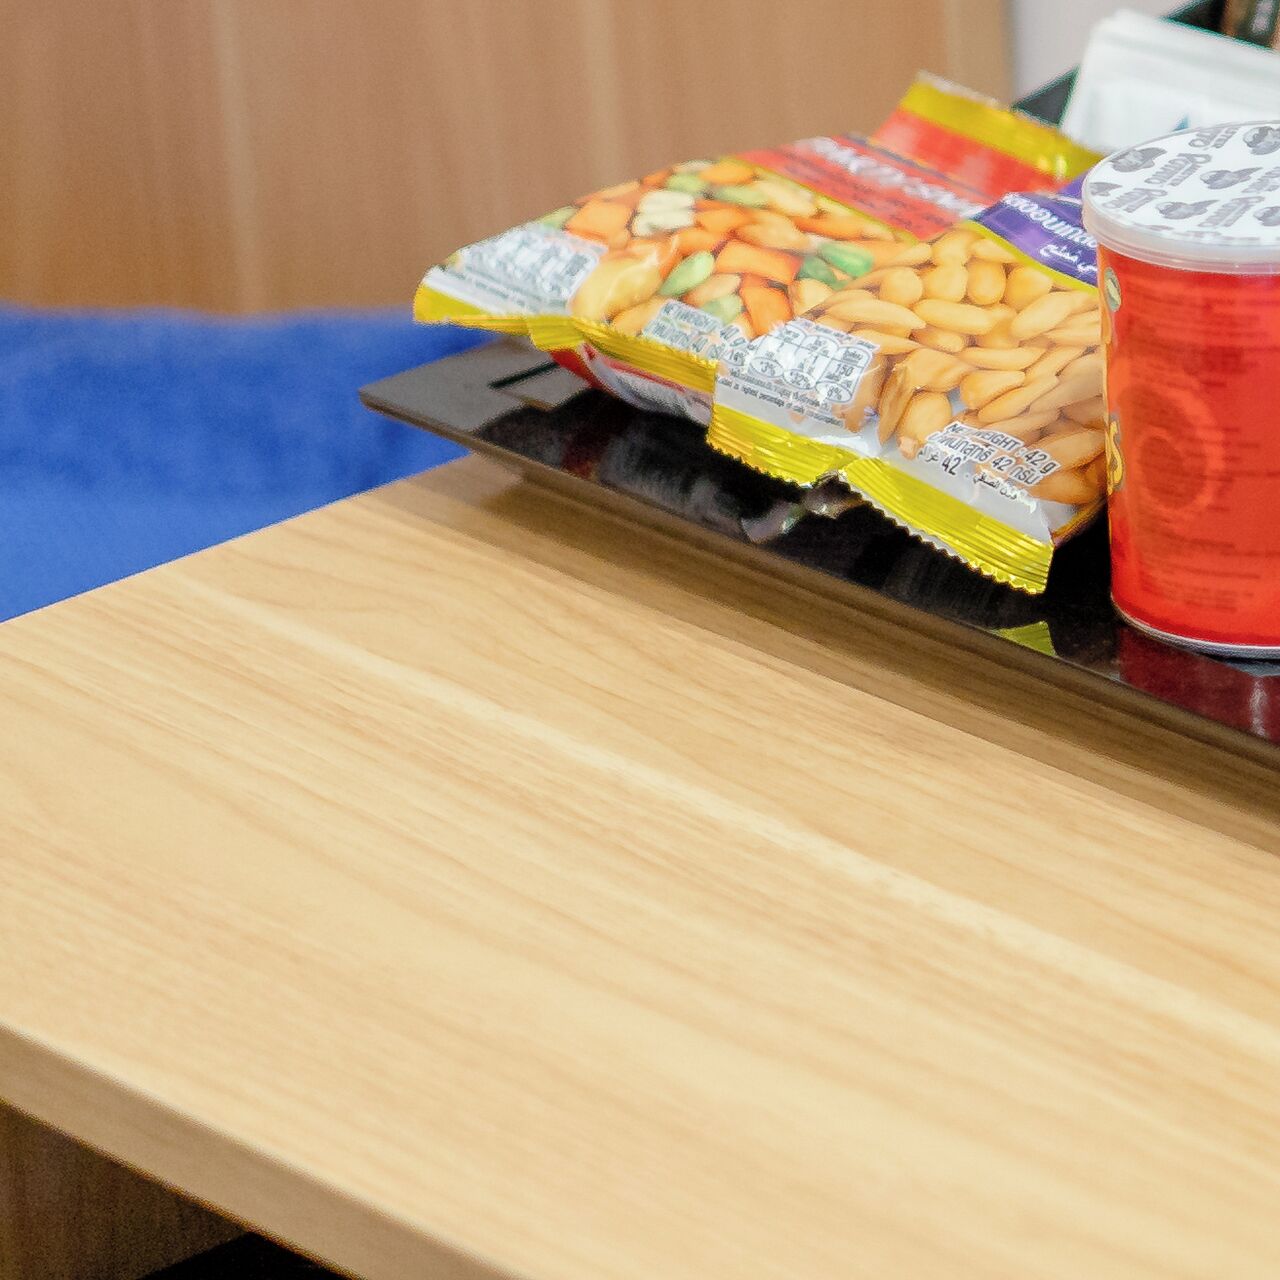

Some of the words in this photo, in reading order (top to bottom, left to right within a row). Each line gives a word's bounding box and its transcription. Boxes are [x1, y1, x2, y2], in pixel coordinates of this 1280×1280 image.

[941, 456, 962, 476] 42
[992, 456, 1014, 472] 42
[1024, 450, 1048, 467] 42
[1040, 461, 1058, 475] g
